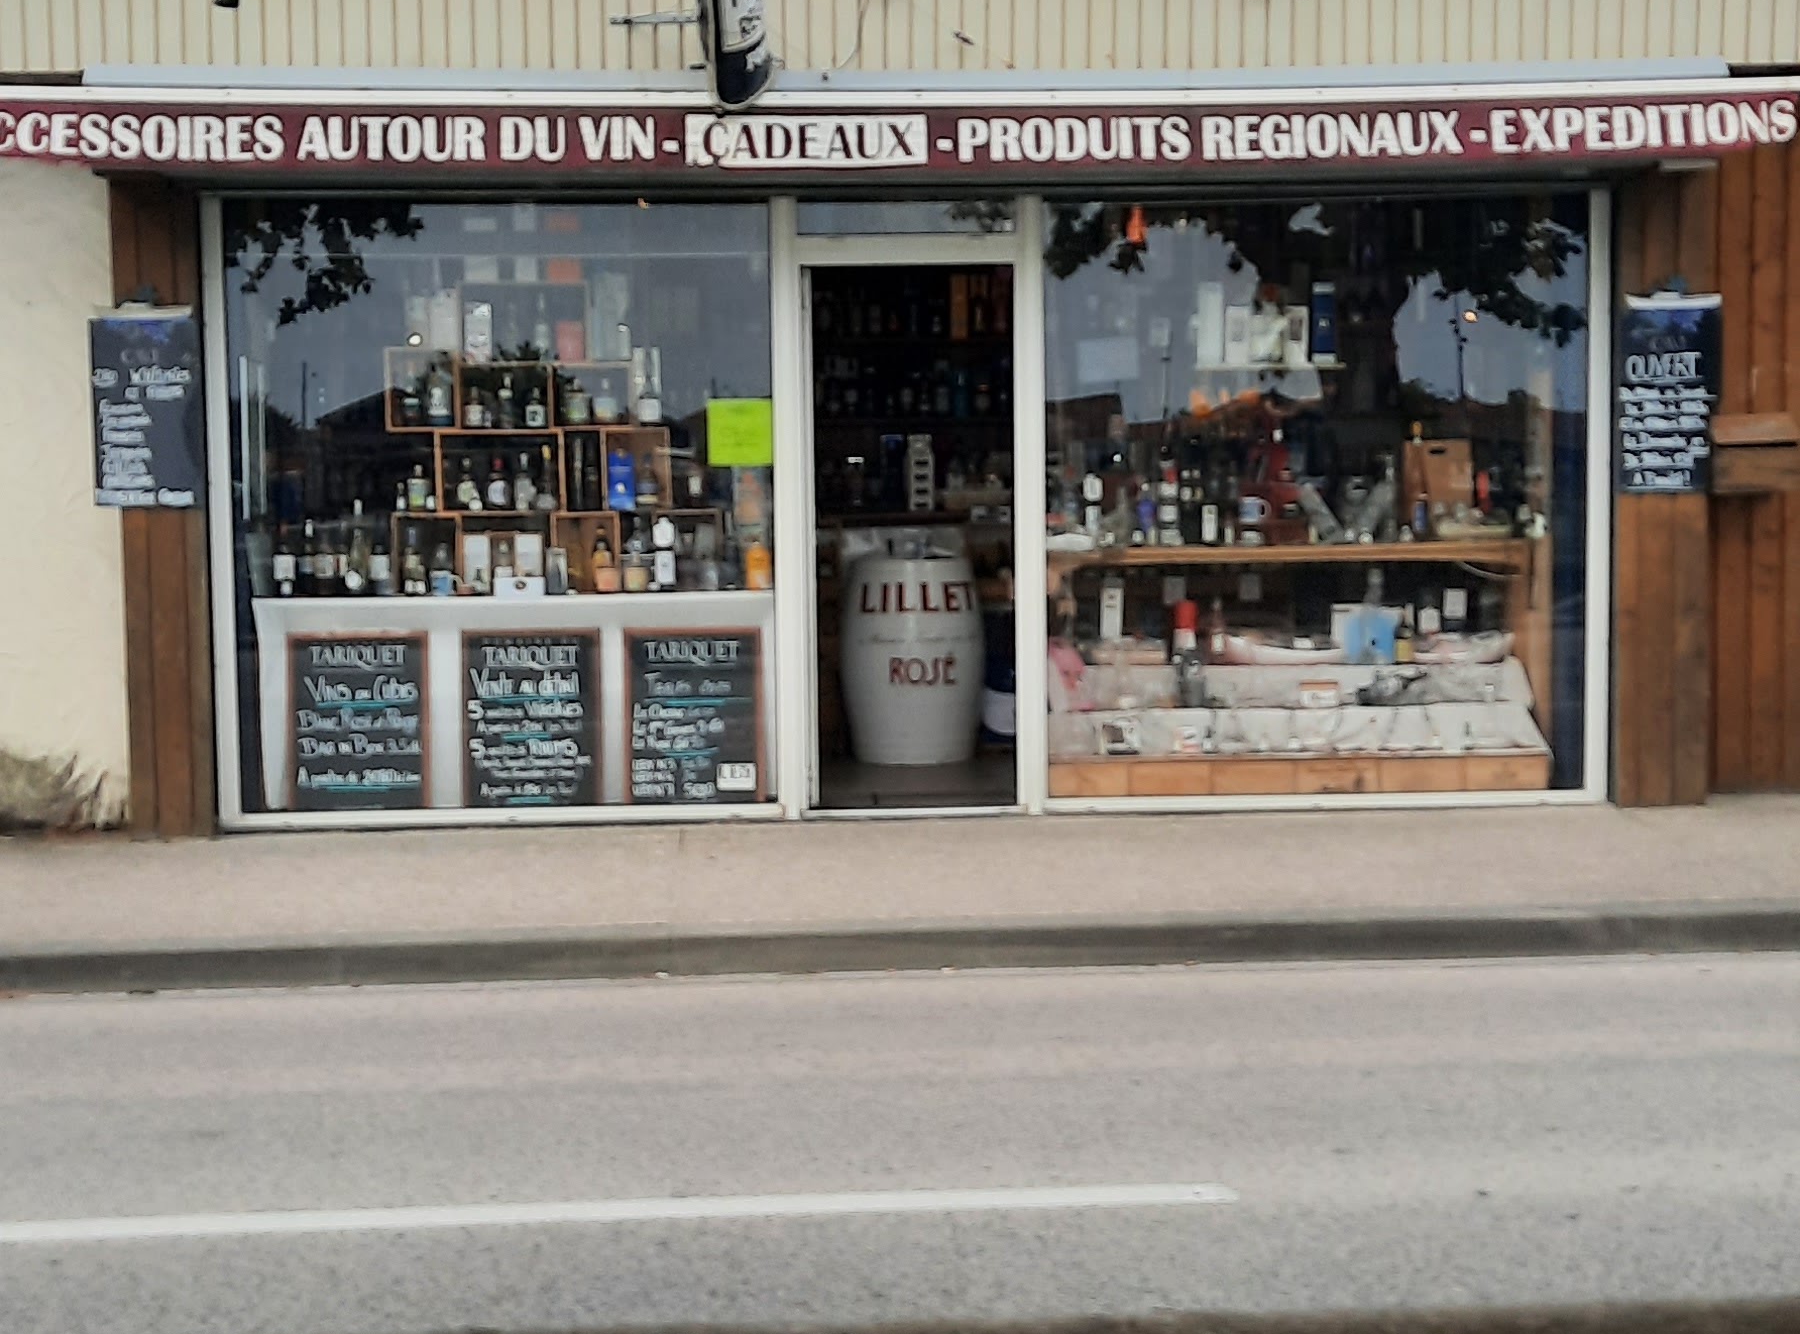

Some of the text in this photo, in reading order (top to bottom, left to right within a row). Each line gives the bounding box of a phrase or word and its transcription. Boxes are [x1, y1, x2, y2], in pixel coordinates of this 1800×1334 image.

[296, 115, 487, 162] AUTOUR
[499, 115, 566, 162] DU
[702, 120, 914, 160] CADEAUX
[1200, 110, 1465, 161] REGIONAUX
[859, 580, 975, 615] LILLET
[308, 644, 408, 671] TARIQUET
[481, 645, 580, 671] TARIQUET
[644, 640, 740, 667] TARIQUET
[888, 651, 957, 686] ROSÉ
